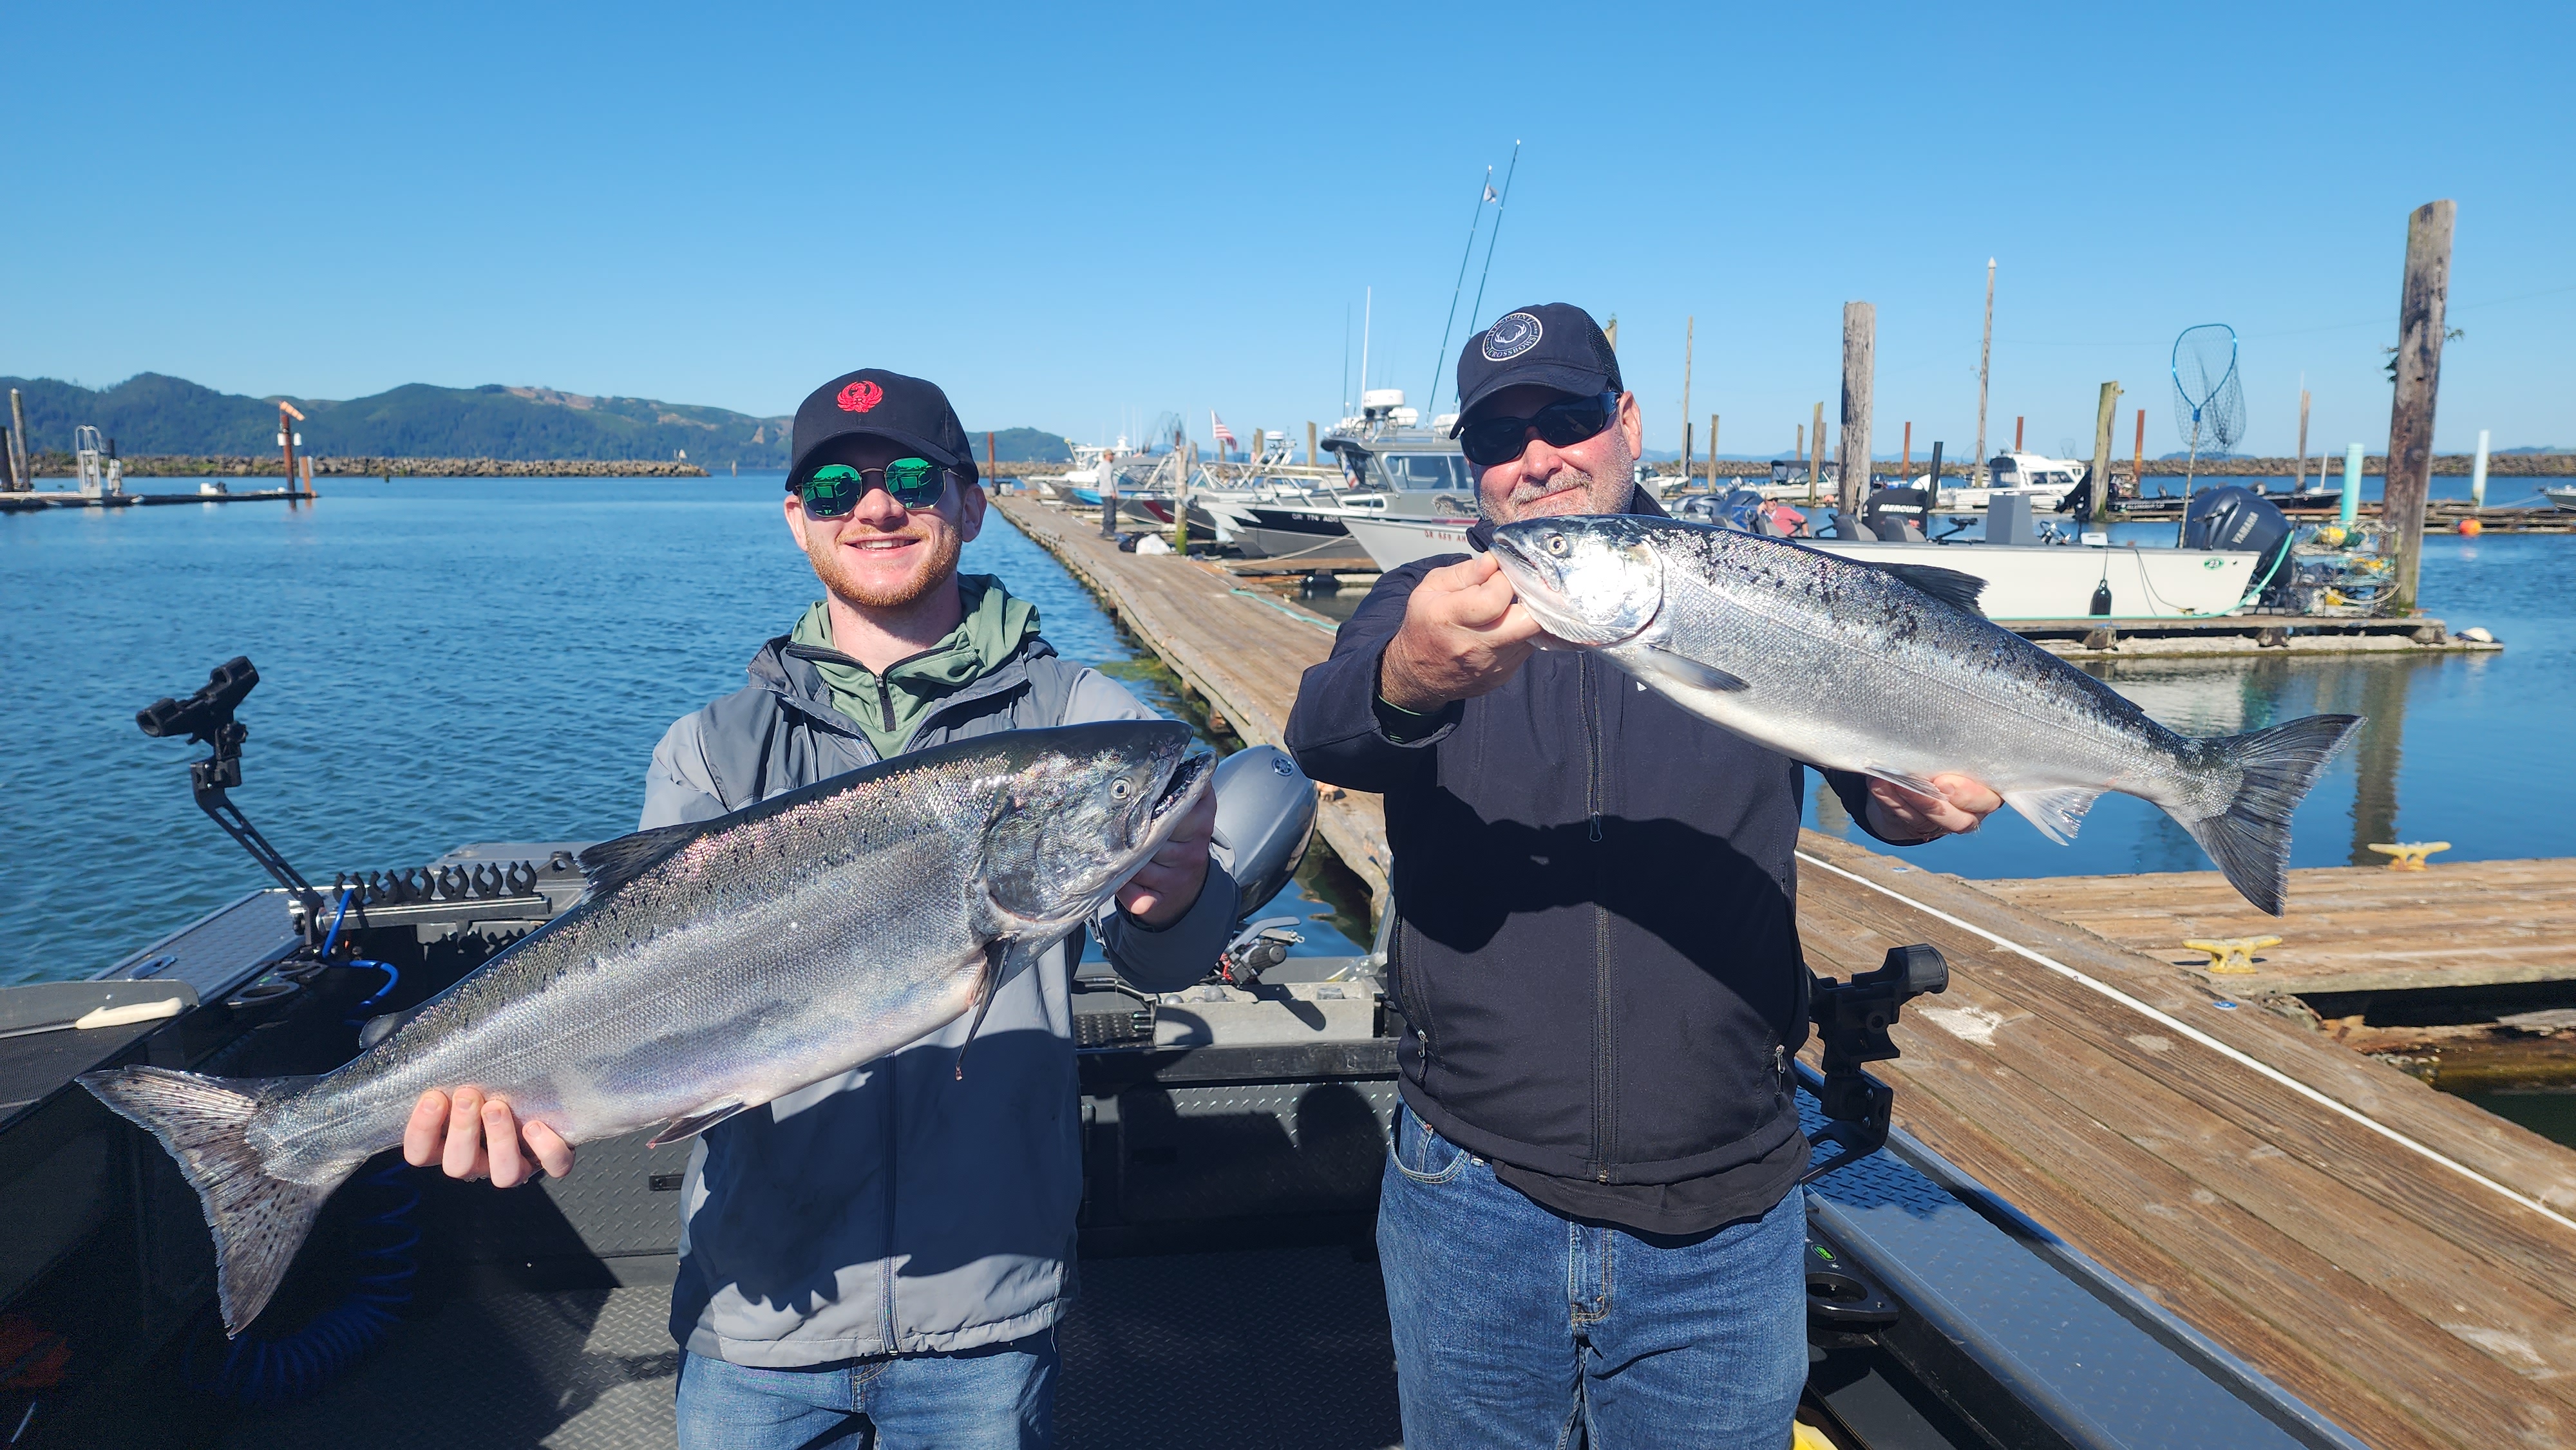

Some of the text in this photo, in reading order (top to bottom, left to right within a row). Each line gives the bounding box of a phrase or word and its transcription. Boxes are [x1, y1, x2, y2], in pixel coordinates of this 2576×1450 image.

[1488, 336, 1537, 358] CROSSBOWS
[1879, 504, 1923, 514] MERCURY
[1424, 530, 1434, 539] OR
[2231, 511, 2259, 544] YAMAHA
